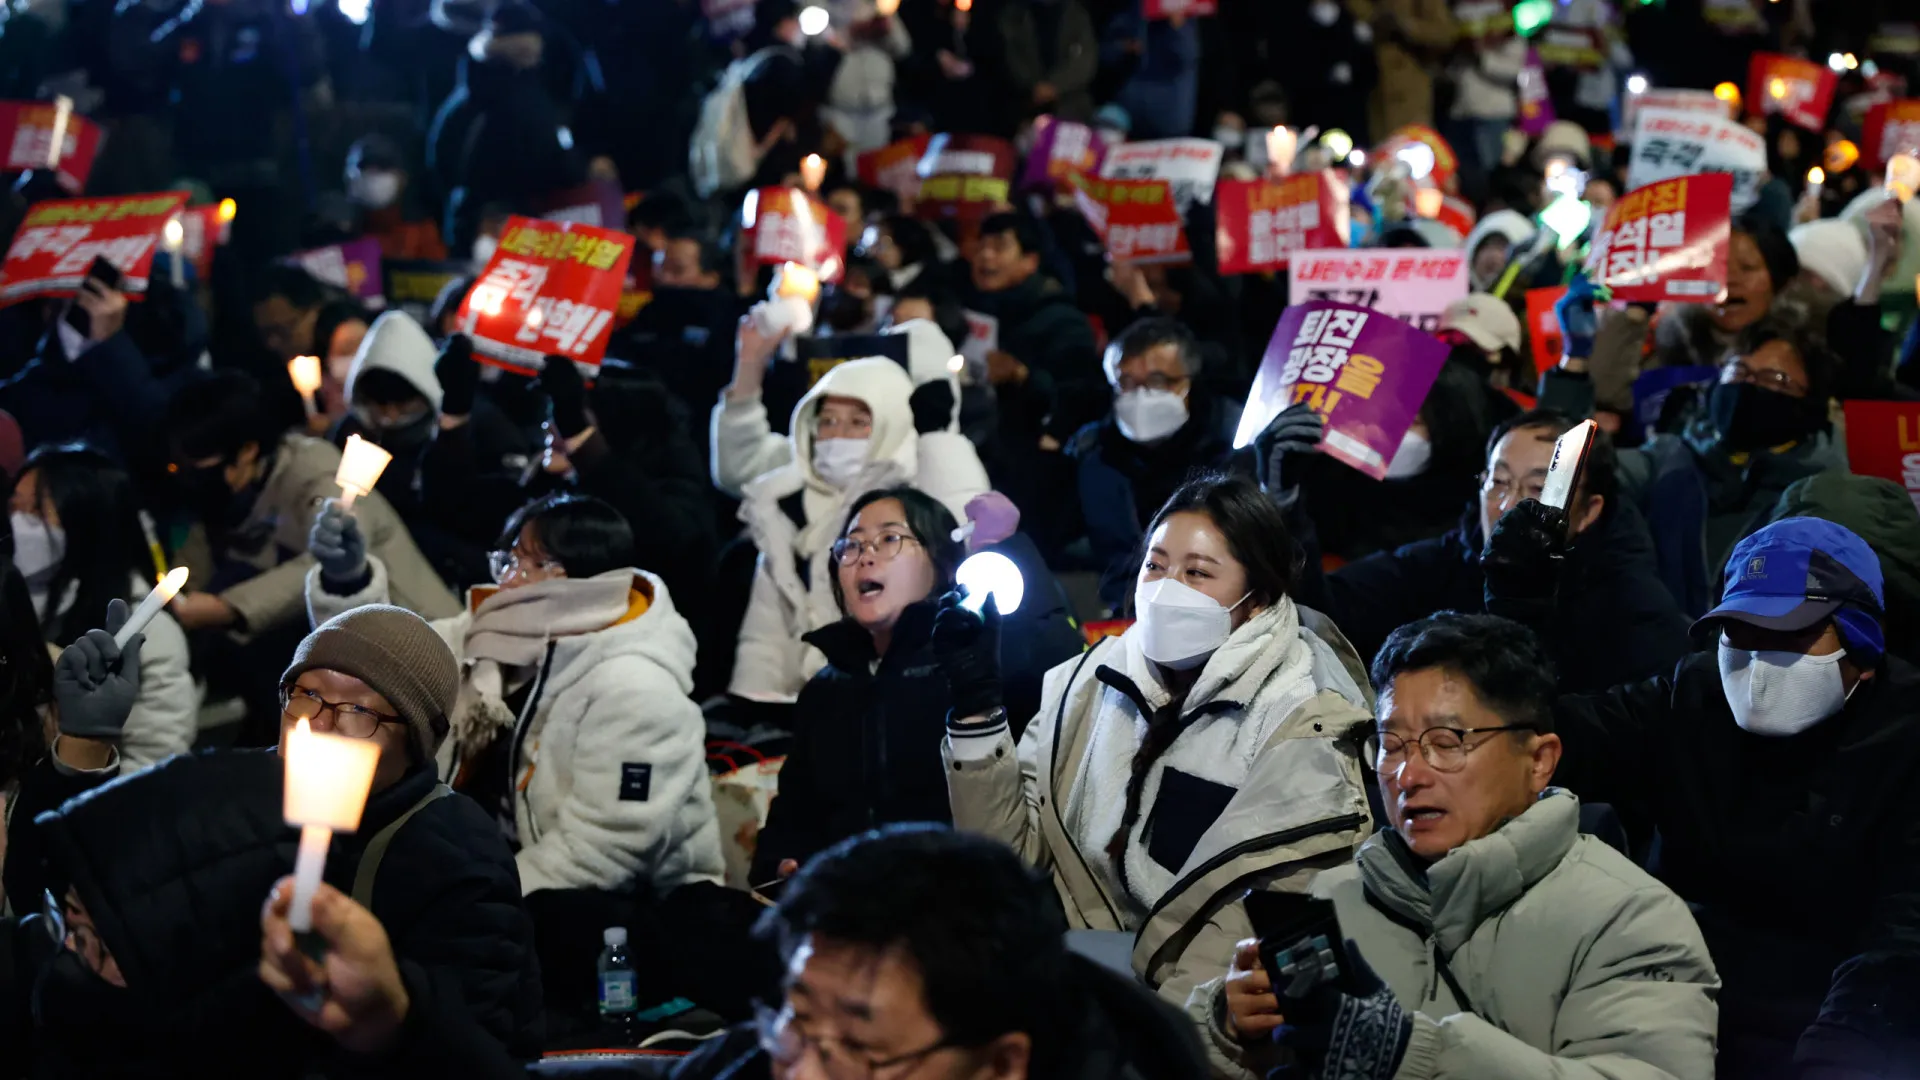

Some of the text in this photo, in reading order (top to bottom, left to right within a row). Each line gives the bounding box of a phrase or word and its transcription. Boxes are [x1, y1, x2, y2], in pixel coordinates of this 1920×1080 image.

[1296, 257, 1463, 283] 내란수괴 윤석열
[1293, 309, 1368, 350] 퇴진
